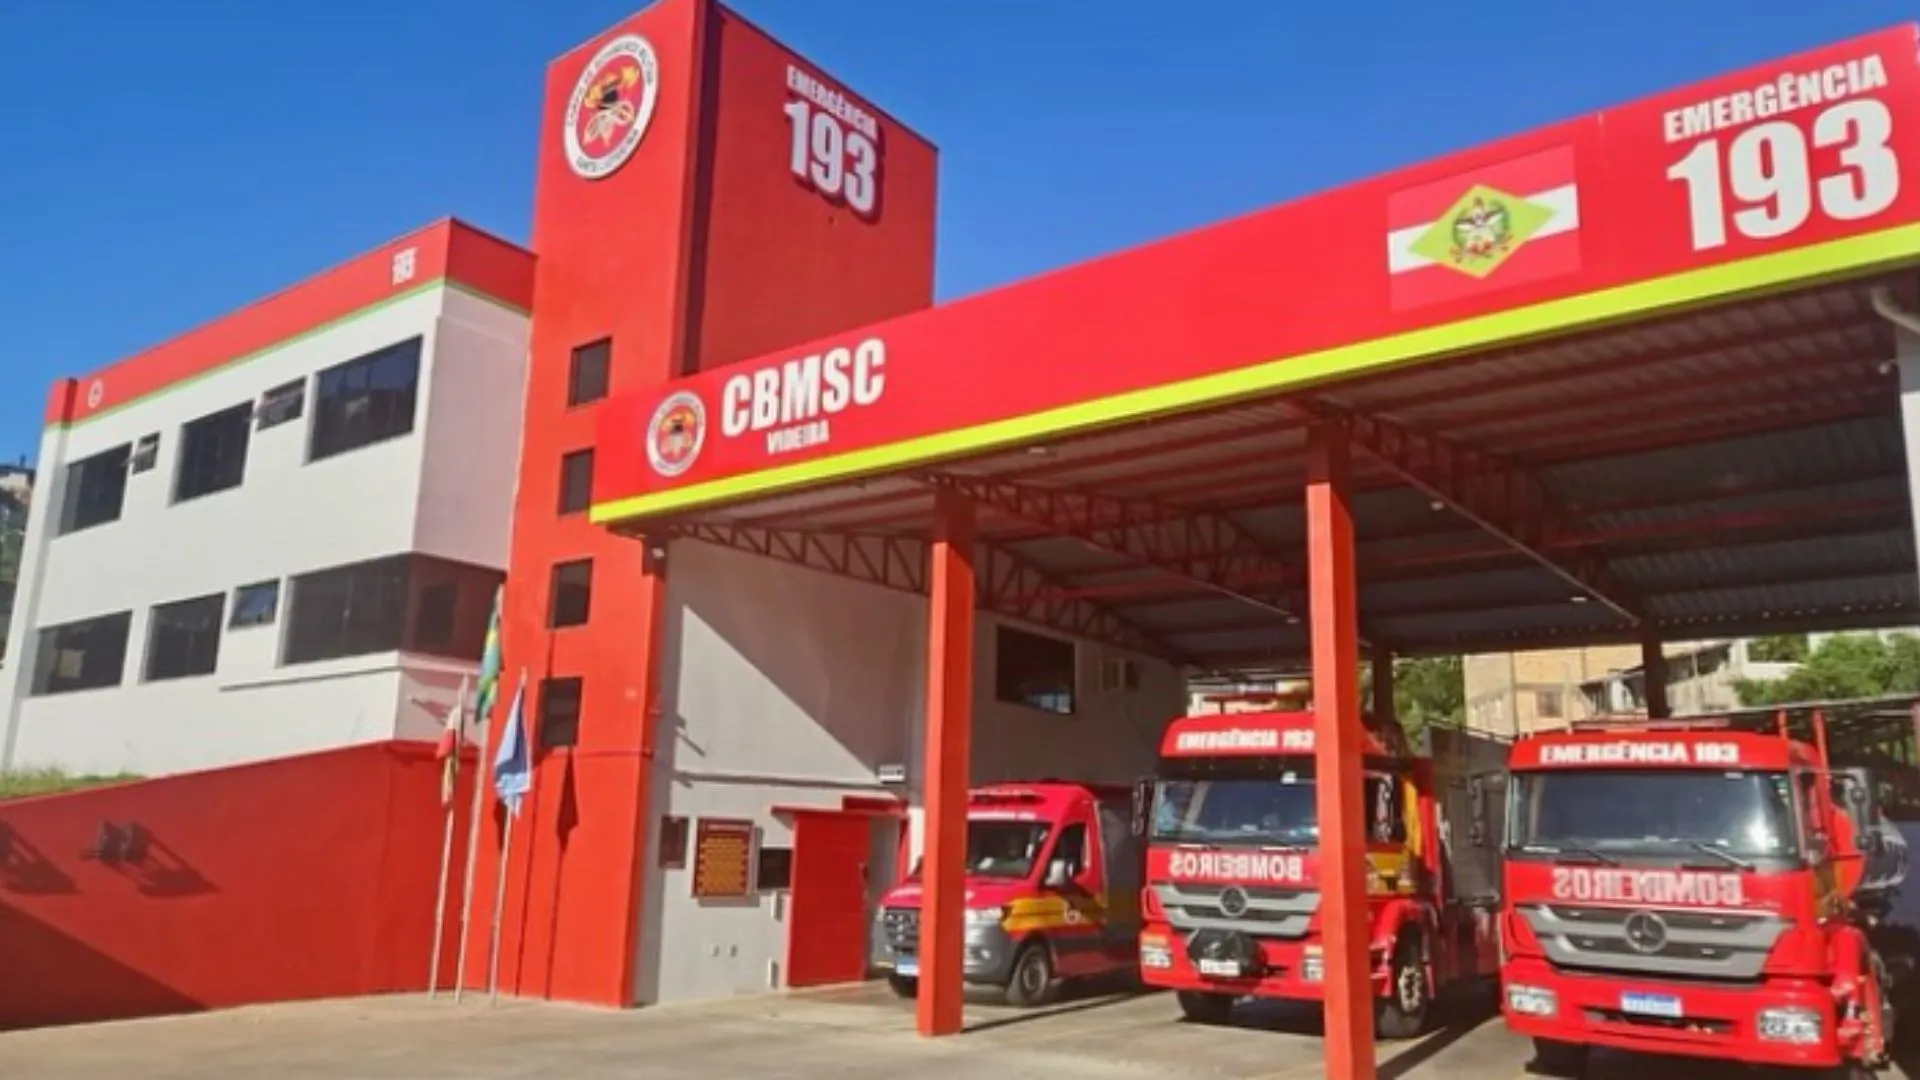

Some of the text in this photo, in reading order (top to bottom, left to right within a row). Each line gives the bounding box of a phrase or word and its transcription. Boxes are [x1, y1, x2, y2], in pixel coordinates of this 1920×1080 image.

[787, 64, 877, 141] EMERGÊNCIA
[1663, 53, 1888, 145] EMERGÊNCIA
[783, 100, 877, 213] 193
[1666, 98, 1899, 252] 193
[721, 337, 886, 438] CBMSC
[1540, 740, 1739, 765] EMERGÊNCIA 193
